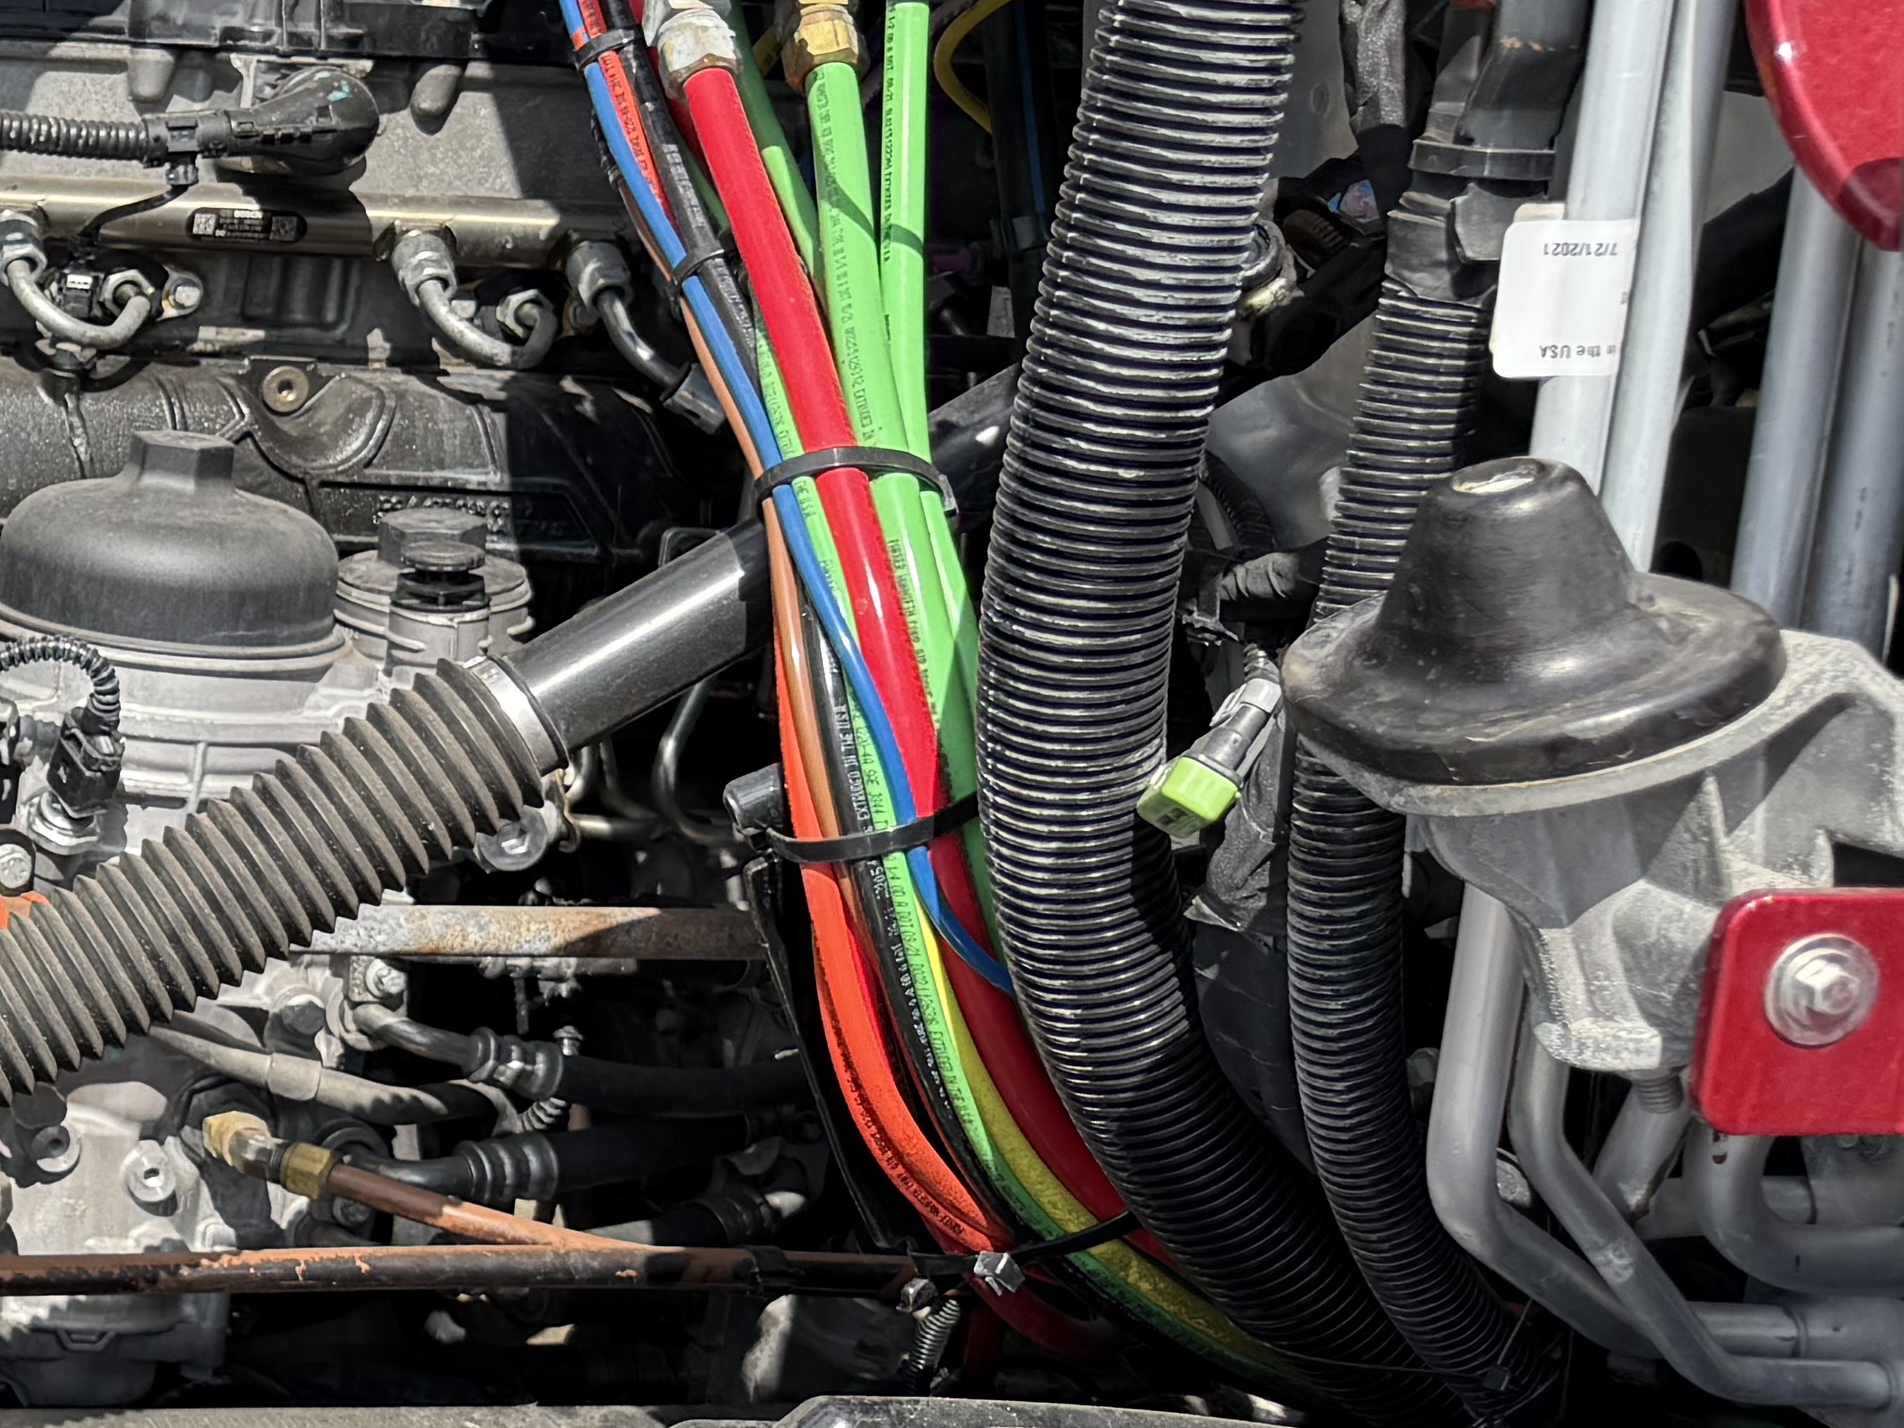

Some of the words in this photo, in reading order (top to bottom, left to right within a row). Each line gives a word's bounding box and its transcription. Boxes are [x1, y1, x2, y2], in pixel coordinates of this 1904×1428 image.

[1543, 243, 1618, 257] 7/21/2021
[1540, 345, 1571, 359] USA
[1576, 345, 1601, 358] the
